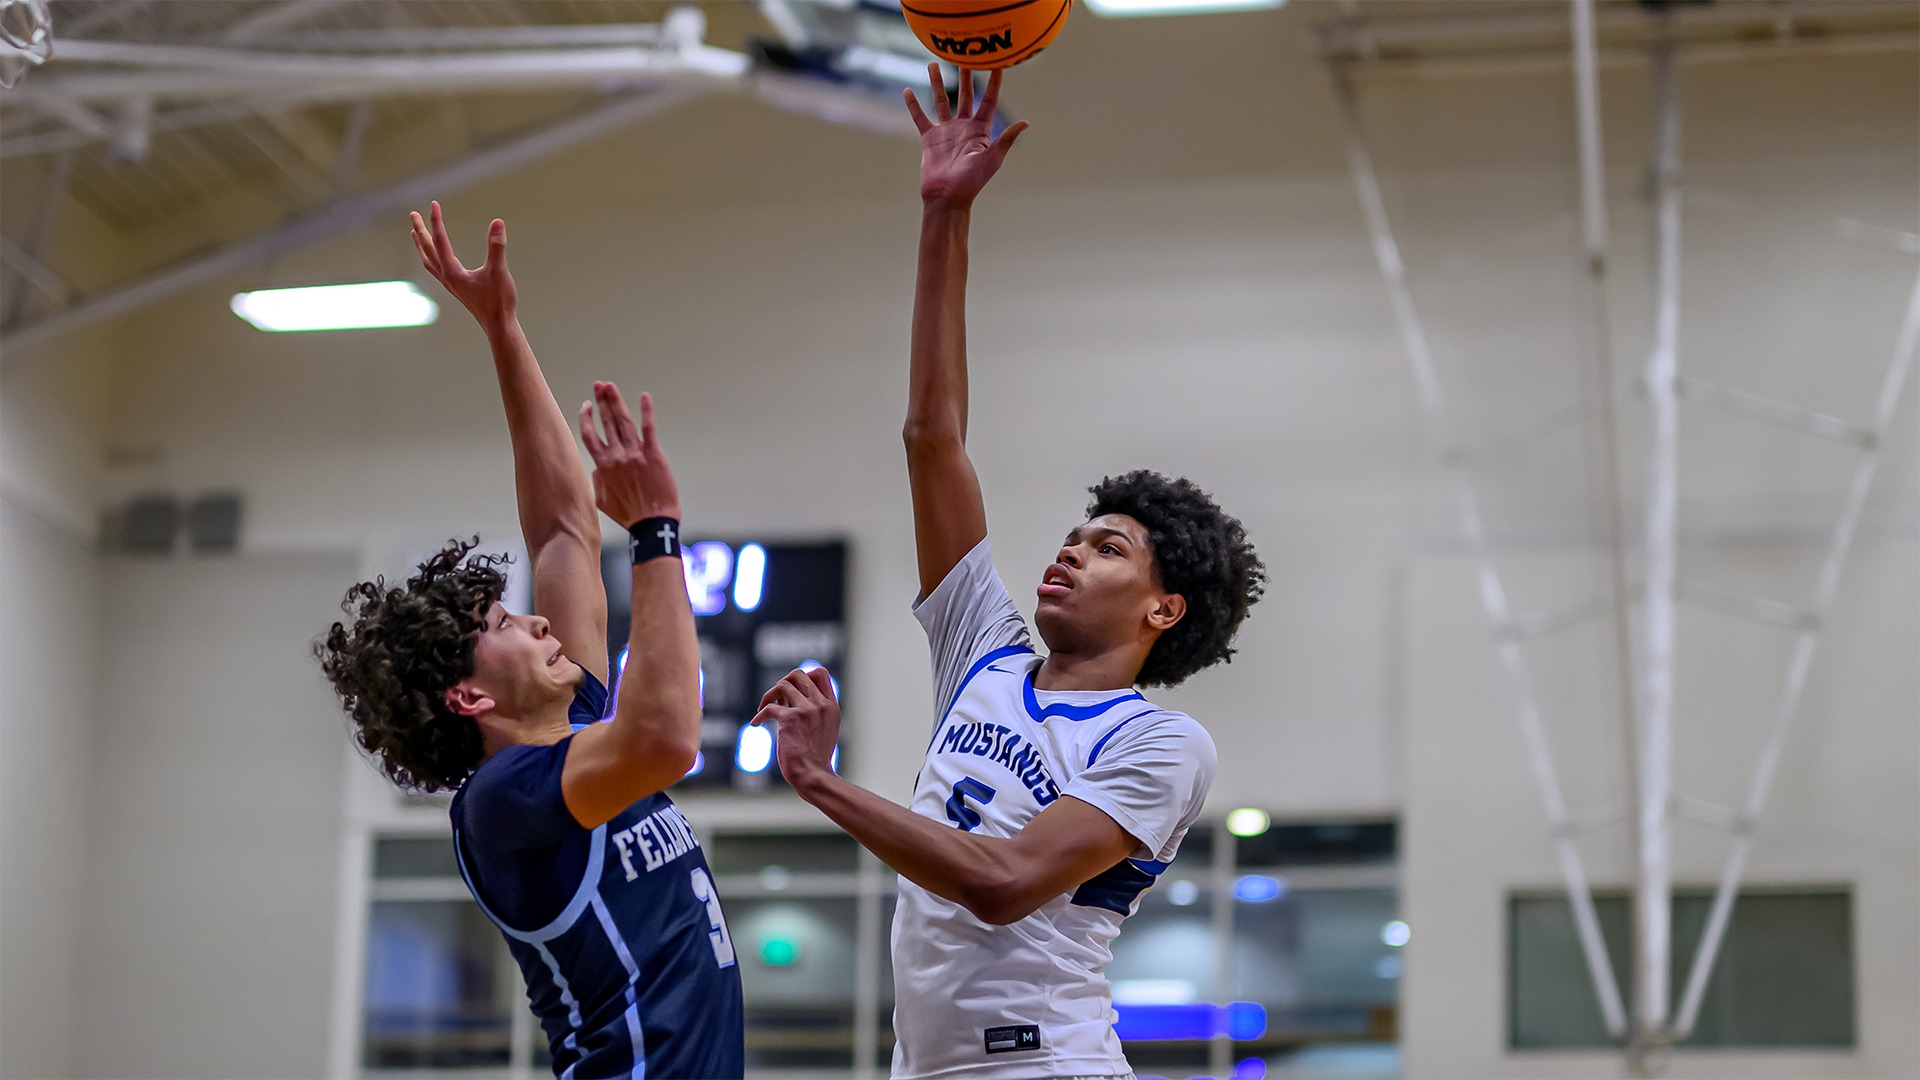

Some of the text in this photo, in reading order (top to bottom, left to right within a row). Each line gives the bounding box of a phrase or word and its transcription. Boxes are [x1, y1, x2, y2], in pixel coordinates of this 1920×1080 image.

[930, 28, 1013, 56] NCAA
[937, 721, 1062, 807] MUSTANGS
[945, 775, 997, 832] 5
[690, 867, 735, 969] 3
[1022, 1032, 1034, 1043] M
